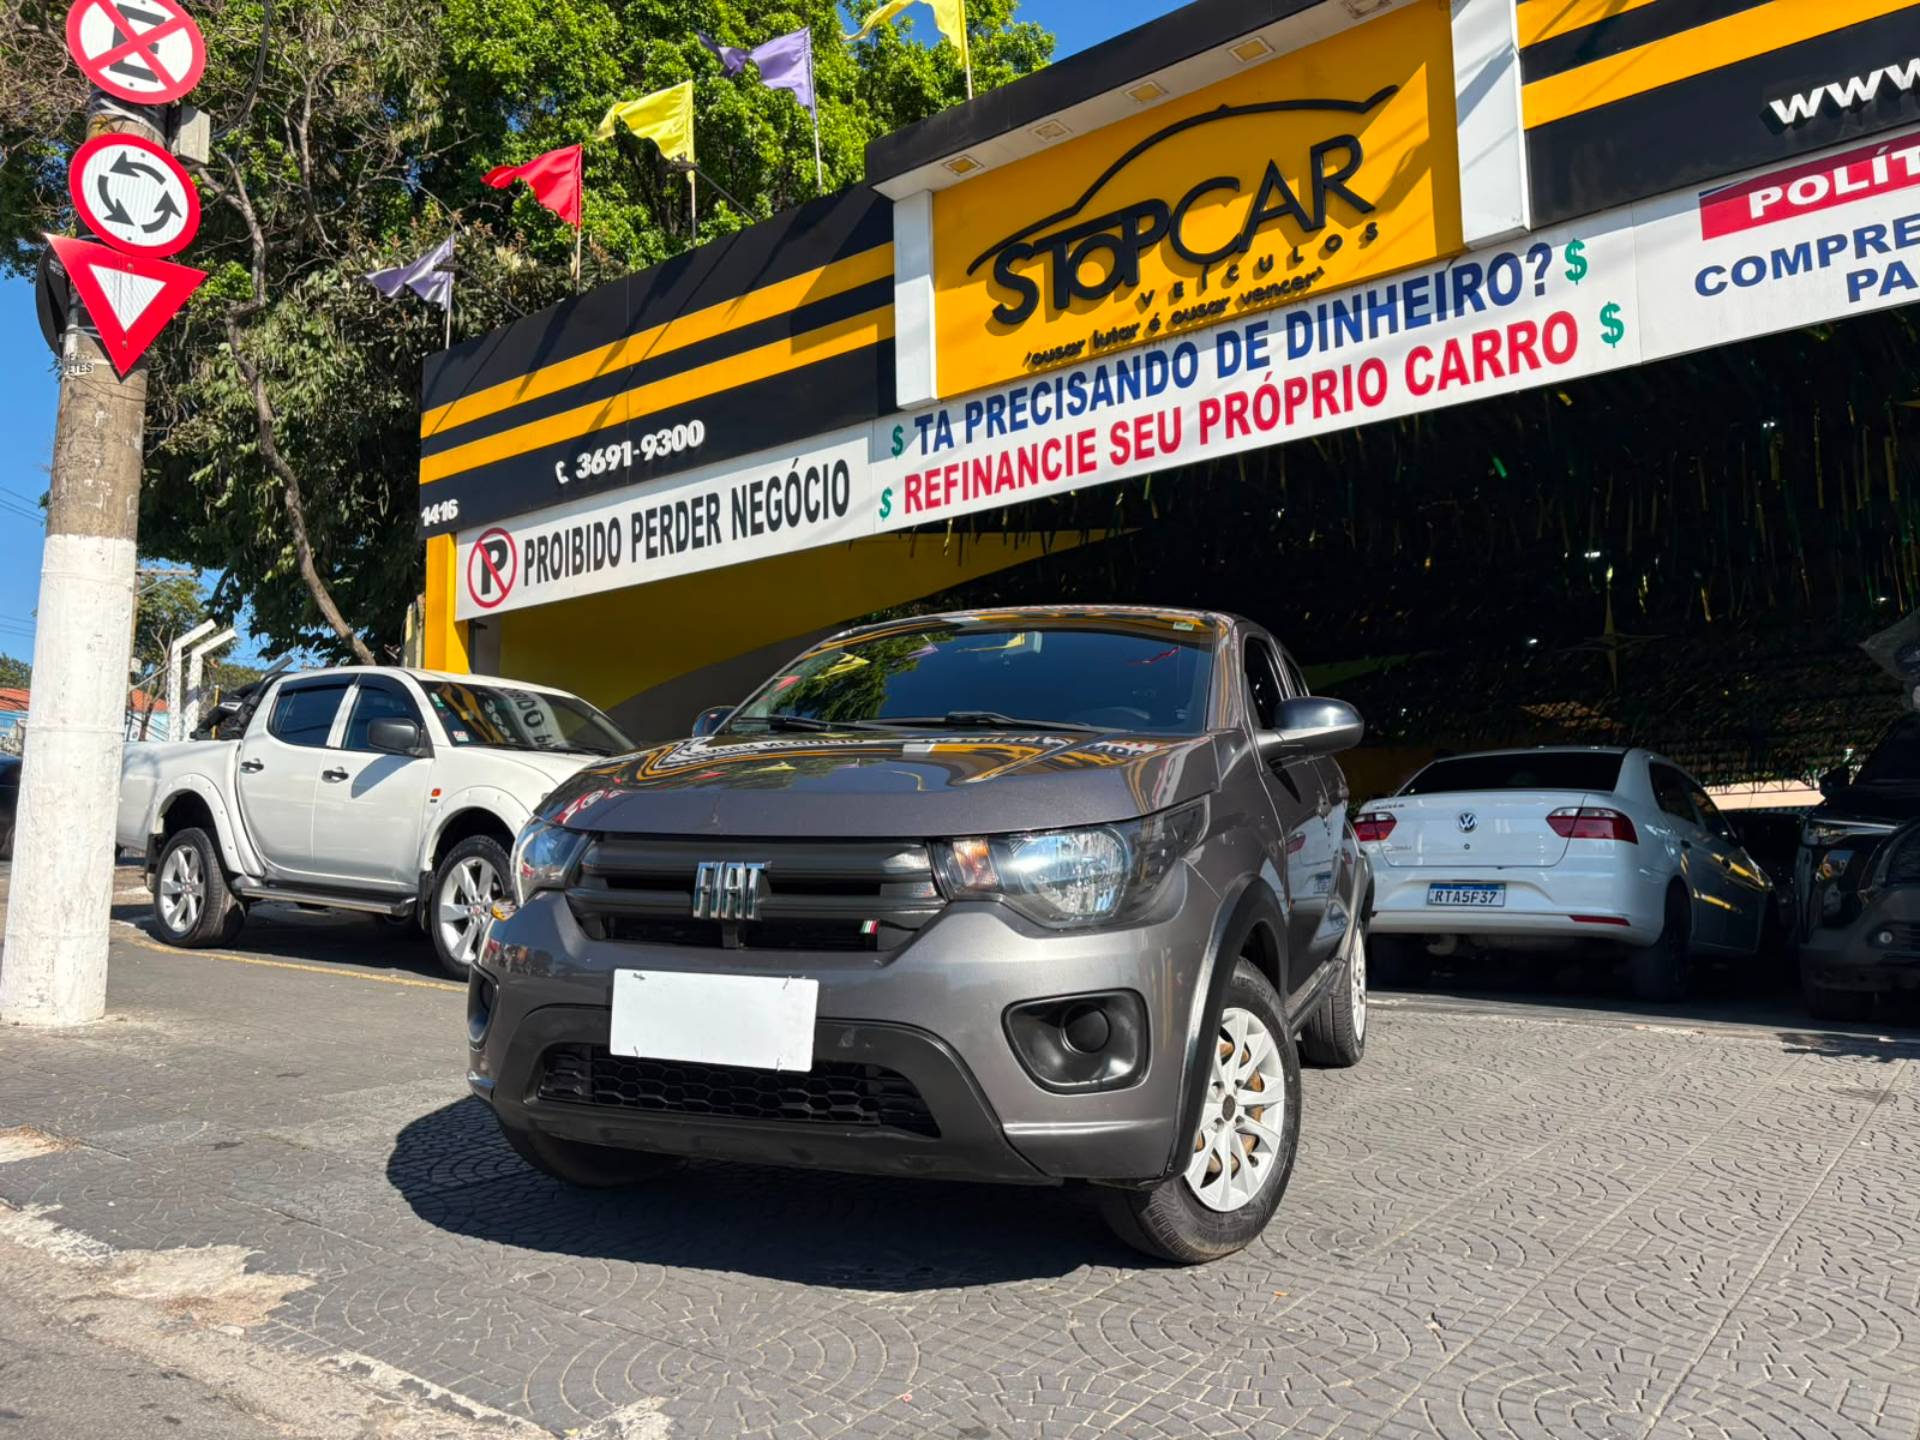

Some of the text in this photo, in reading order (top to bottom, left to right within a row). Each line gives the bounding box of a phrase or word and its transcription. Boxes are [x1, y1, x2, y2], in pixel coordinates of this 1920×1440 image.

[1140, 222, 1378, 305] VEÍCULOS
[1695, 213, 1920, 296] COMPRE
[1846, 260, 1918, 303] PA
[915, 410, 954, 456] TA
[965, 341, 1199, 444] PRECISANDO
[1217, 320, 1270, 378] DE
[1286, 242, 1553, 360] DINHEIRO?
[1094, 323, 1140, 347] lutar
[1171, 296, 1231, 325] ousar
[904, 428, 1098, 514] REFINANCIE
[1109, 406, 1182, 466] SEU
[1199, 357, 1388, 446] PRÓPRIO
[1404, 310, 1578, 397] CARRO
[575, 419, 706, 481] 3691-9300
[421, 498, 459, 527] 1416
[524, 458, 850, 587] PROIBIDO PERDER NEGÓCIO
[693, 862, 766, 919] FIAT
[1434, 890, 1497, 904] RTA5F37
